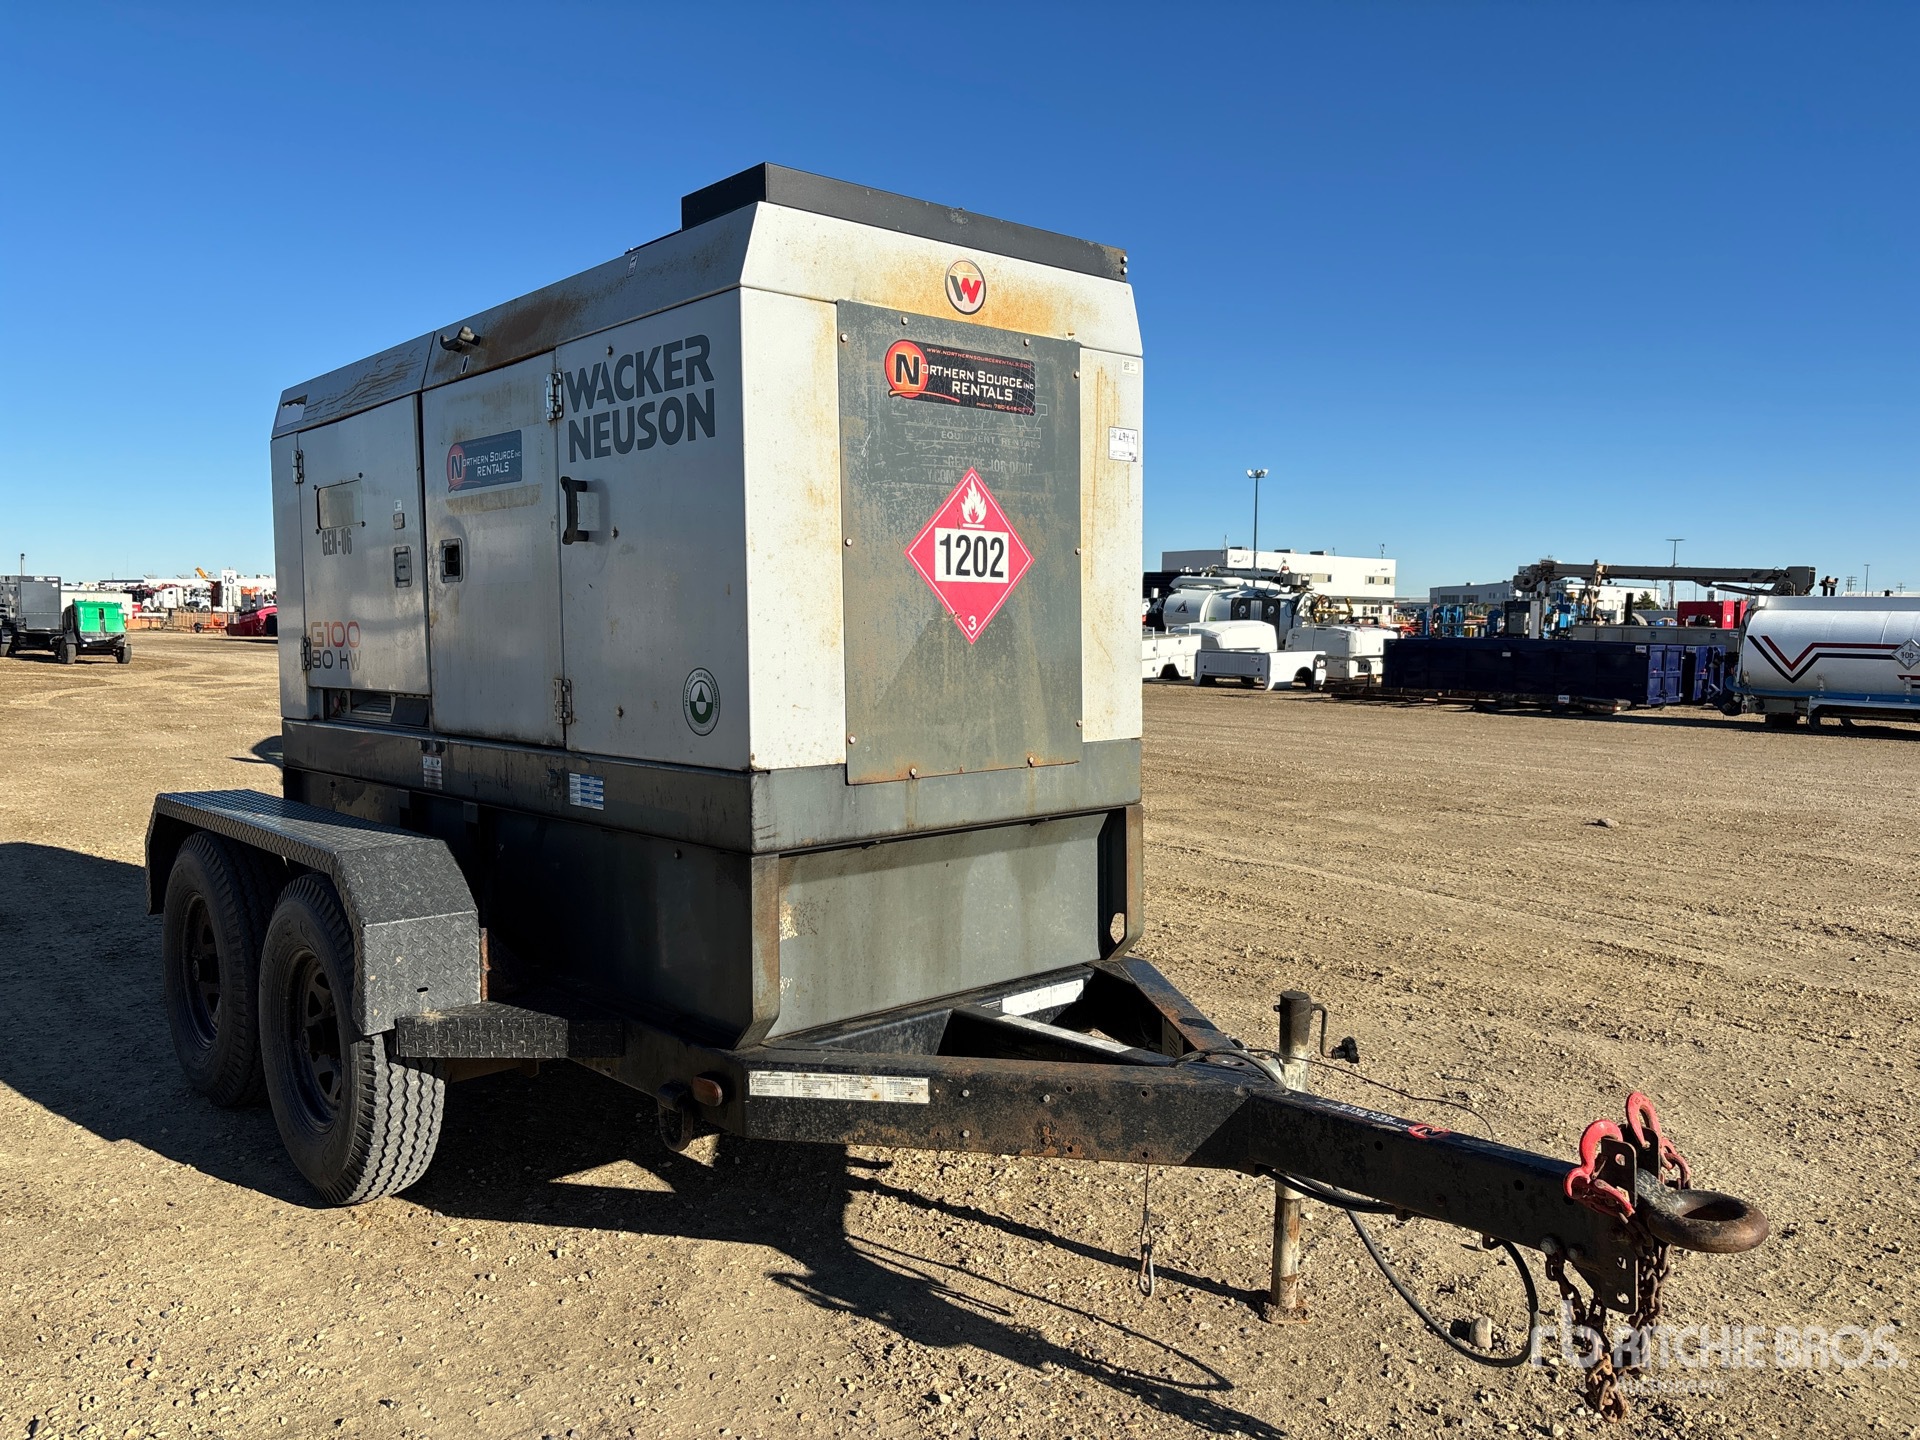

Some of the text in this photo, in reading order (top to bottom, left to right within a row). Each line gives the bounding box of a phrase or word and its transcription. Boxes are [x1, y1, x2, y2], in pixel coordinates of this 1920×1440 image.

[564, 334, 715, 413] WACKER
[952, 381, 1013, 401] RENTALS
[568, 388, 716, 463] NEUSON
[477, 462, 509, 477] RENTALS
[939, 533, 1004, 578] 1202
[223, 575, 235, 584] 16
[968, 615, 977, 631] 3
[311, 621, 361, 648] G100
[312, 650, 333, 669] 80
